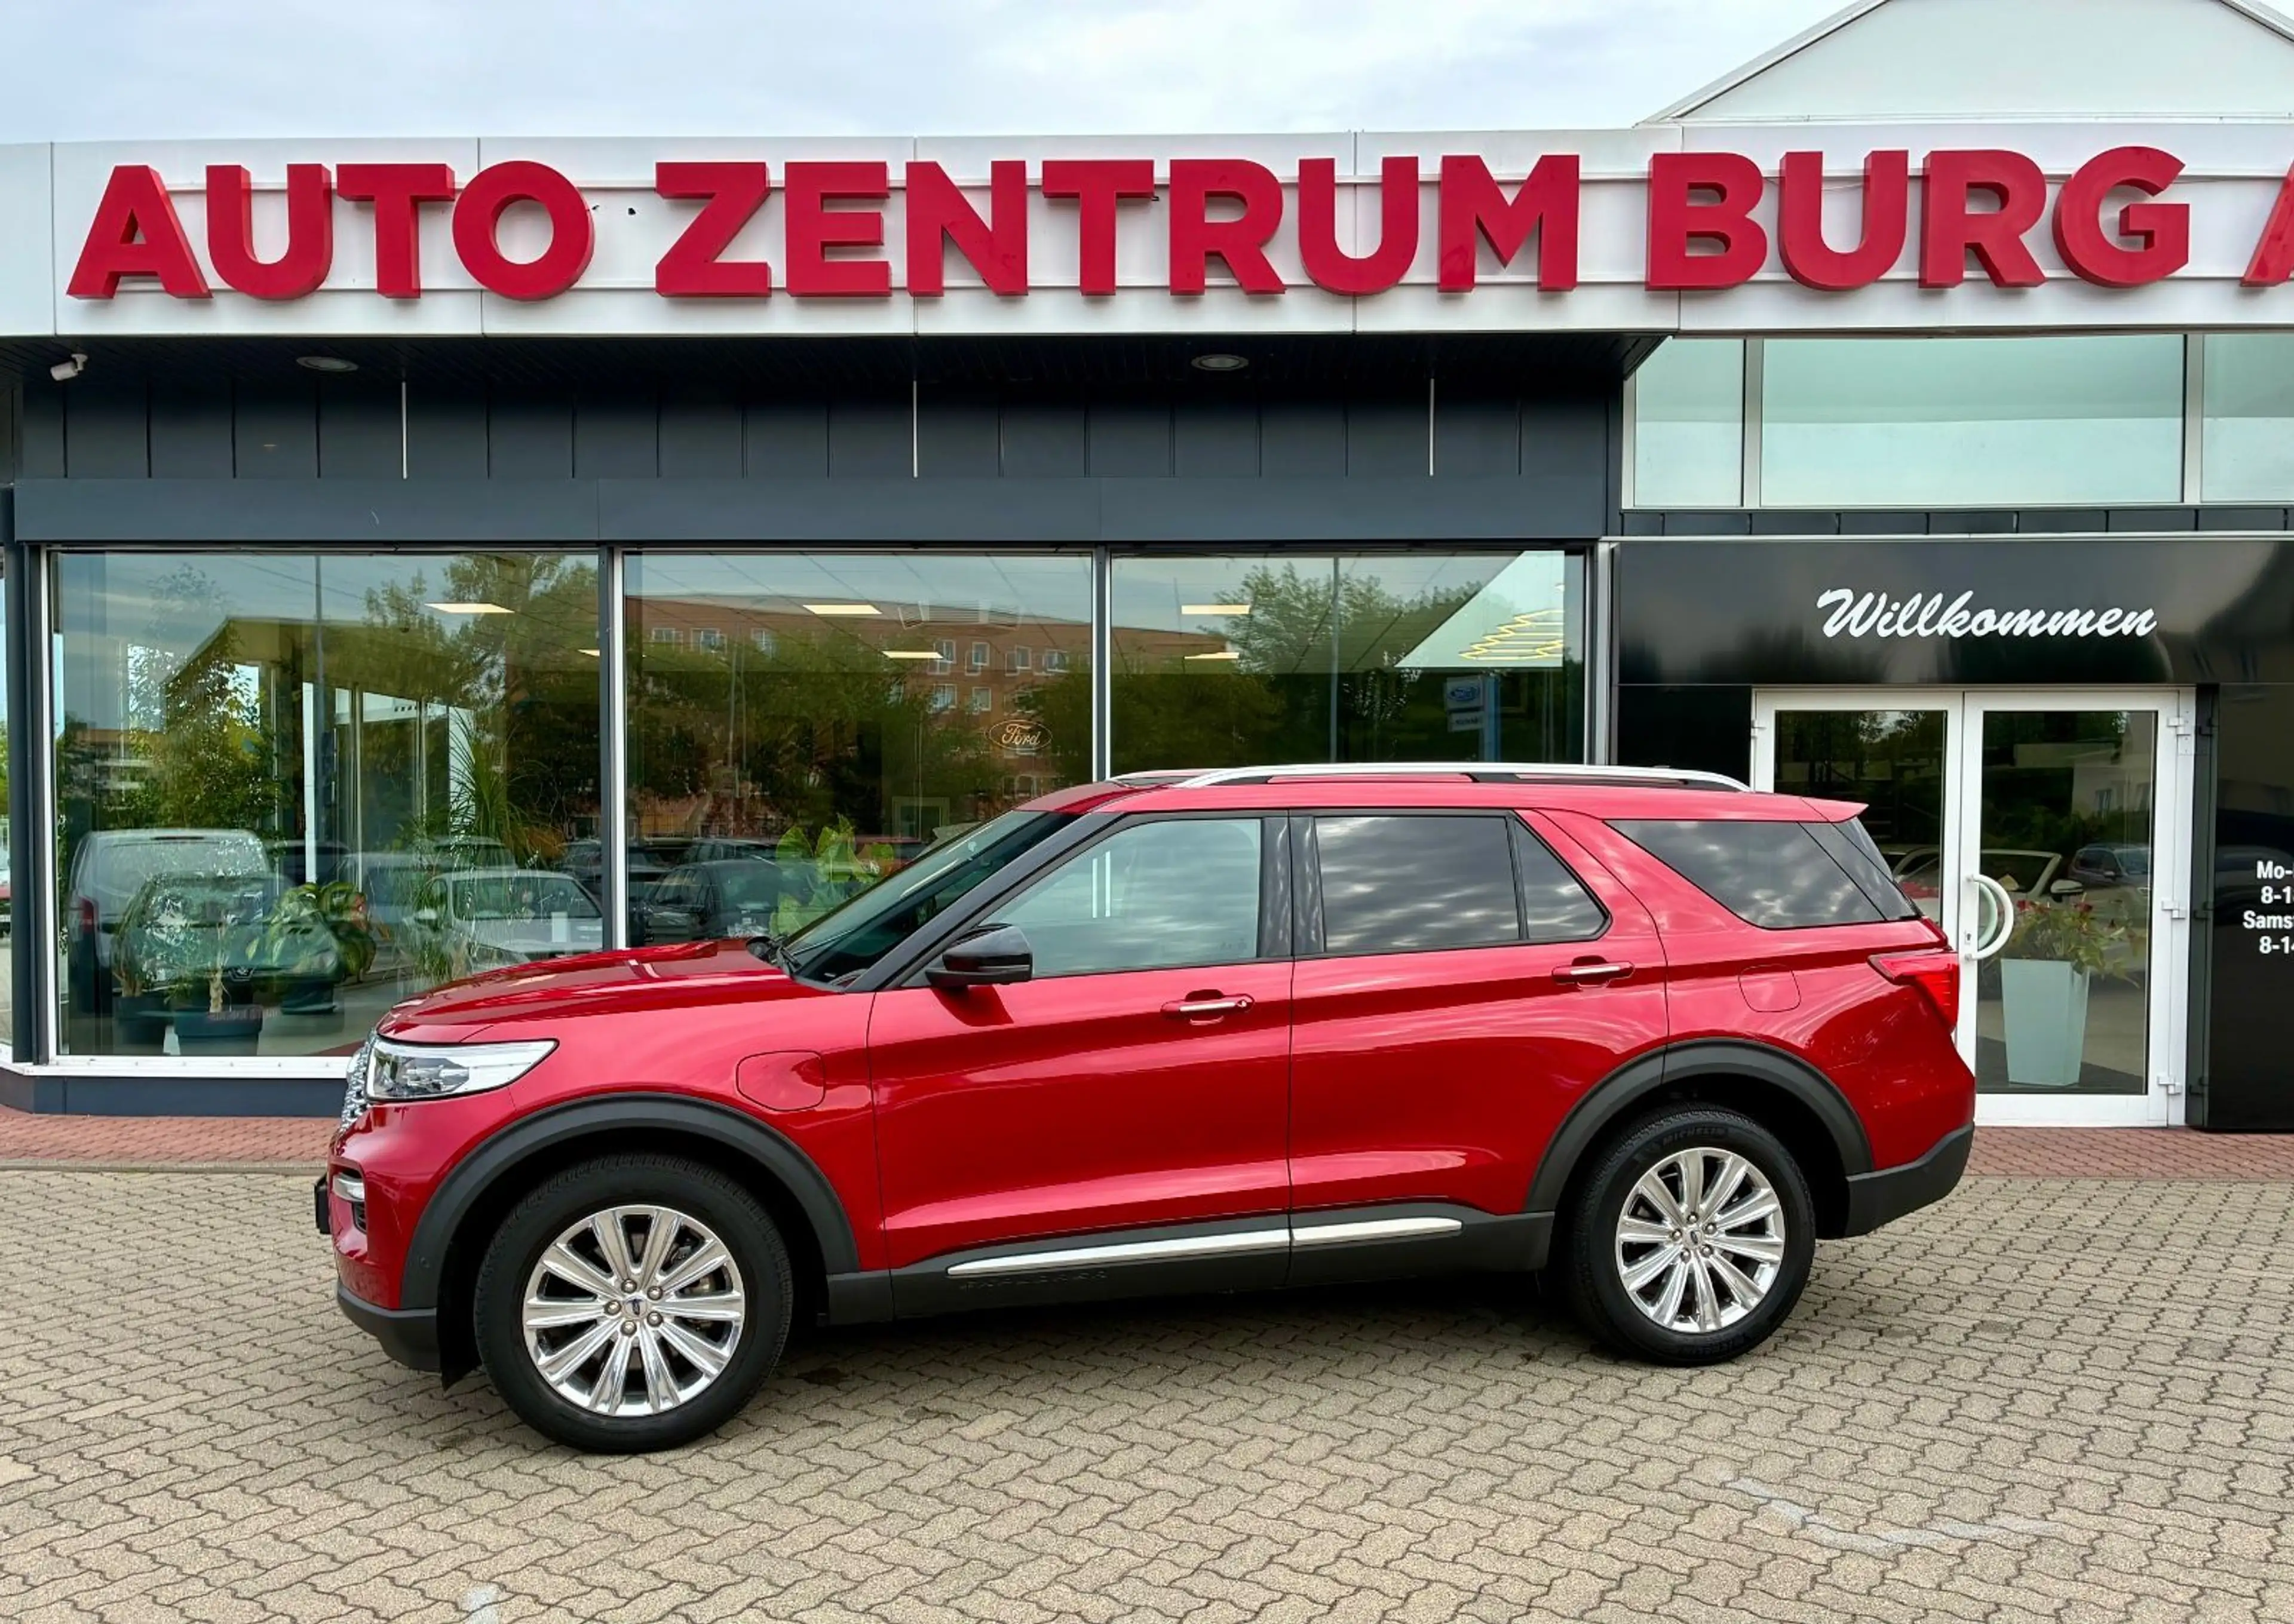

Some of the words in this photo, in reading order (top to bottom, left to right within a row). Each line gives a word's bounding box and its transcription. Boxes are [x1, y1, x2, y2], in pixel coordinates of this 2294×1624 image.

[66, 161, 595, 302] AUTO
[655, 154, 1580, 297] ZENTRUM
[1644, 146, 2190, 291] BURG
[1817, 588, 2157, 638] Willkommen
[1002, 723, 1041, 745] Ford
[2256, 860, 2294, 879] Mo-
[2261, 886, 2294, 904] 8-1
[2243, 910, 2294, 929] Sams
